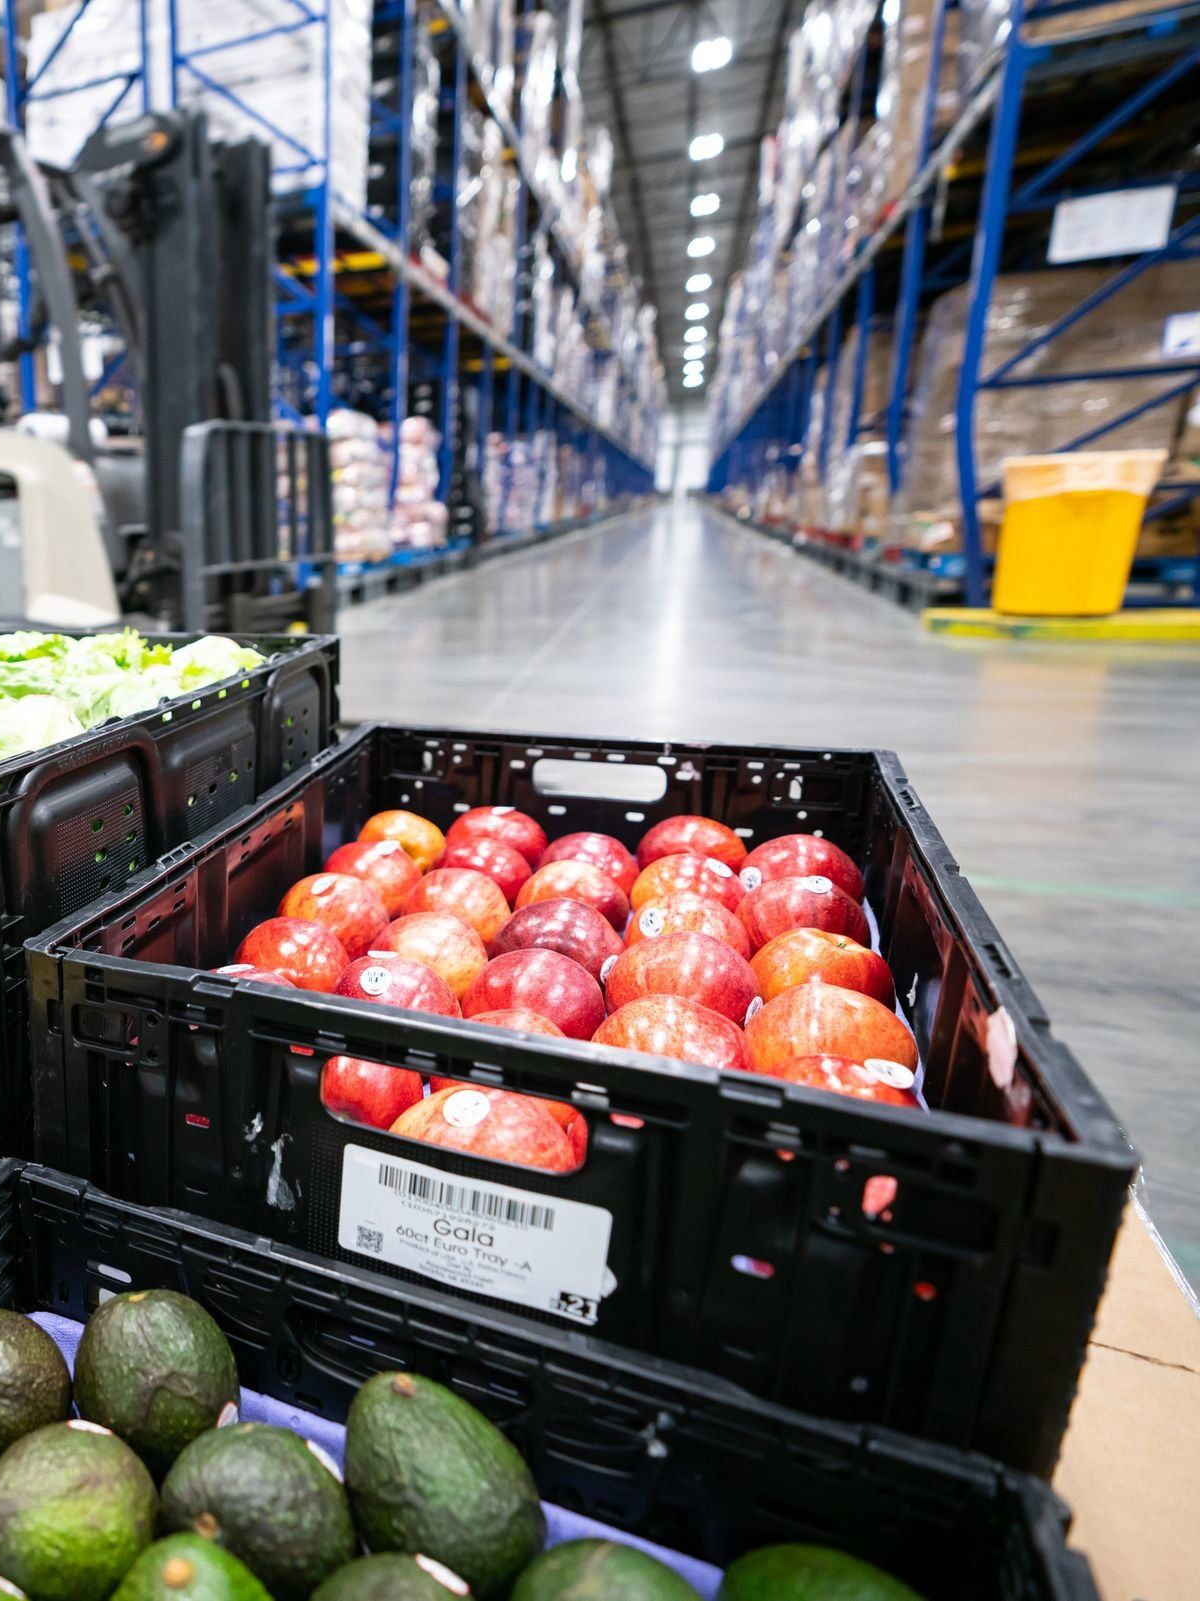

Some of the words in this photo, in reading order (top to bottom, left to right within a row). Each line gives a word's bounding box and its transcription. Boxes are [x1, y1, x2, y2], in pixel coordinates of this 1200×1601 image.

[396, 1226, 429, 1244] 60ct
[434, 1237, 468, 1256] Euro
[473, 1246, 509, 1267] Tray
[434, 1218, 494, 1247] Gala
